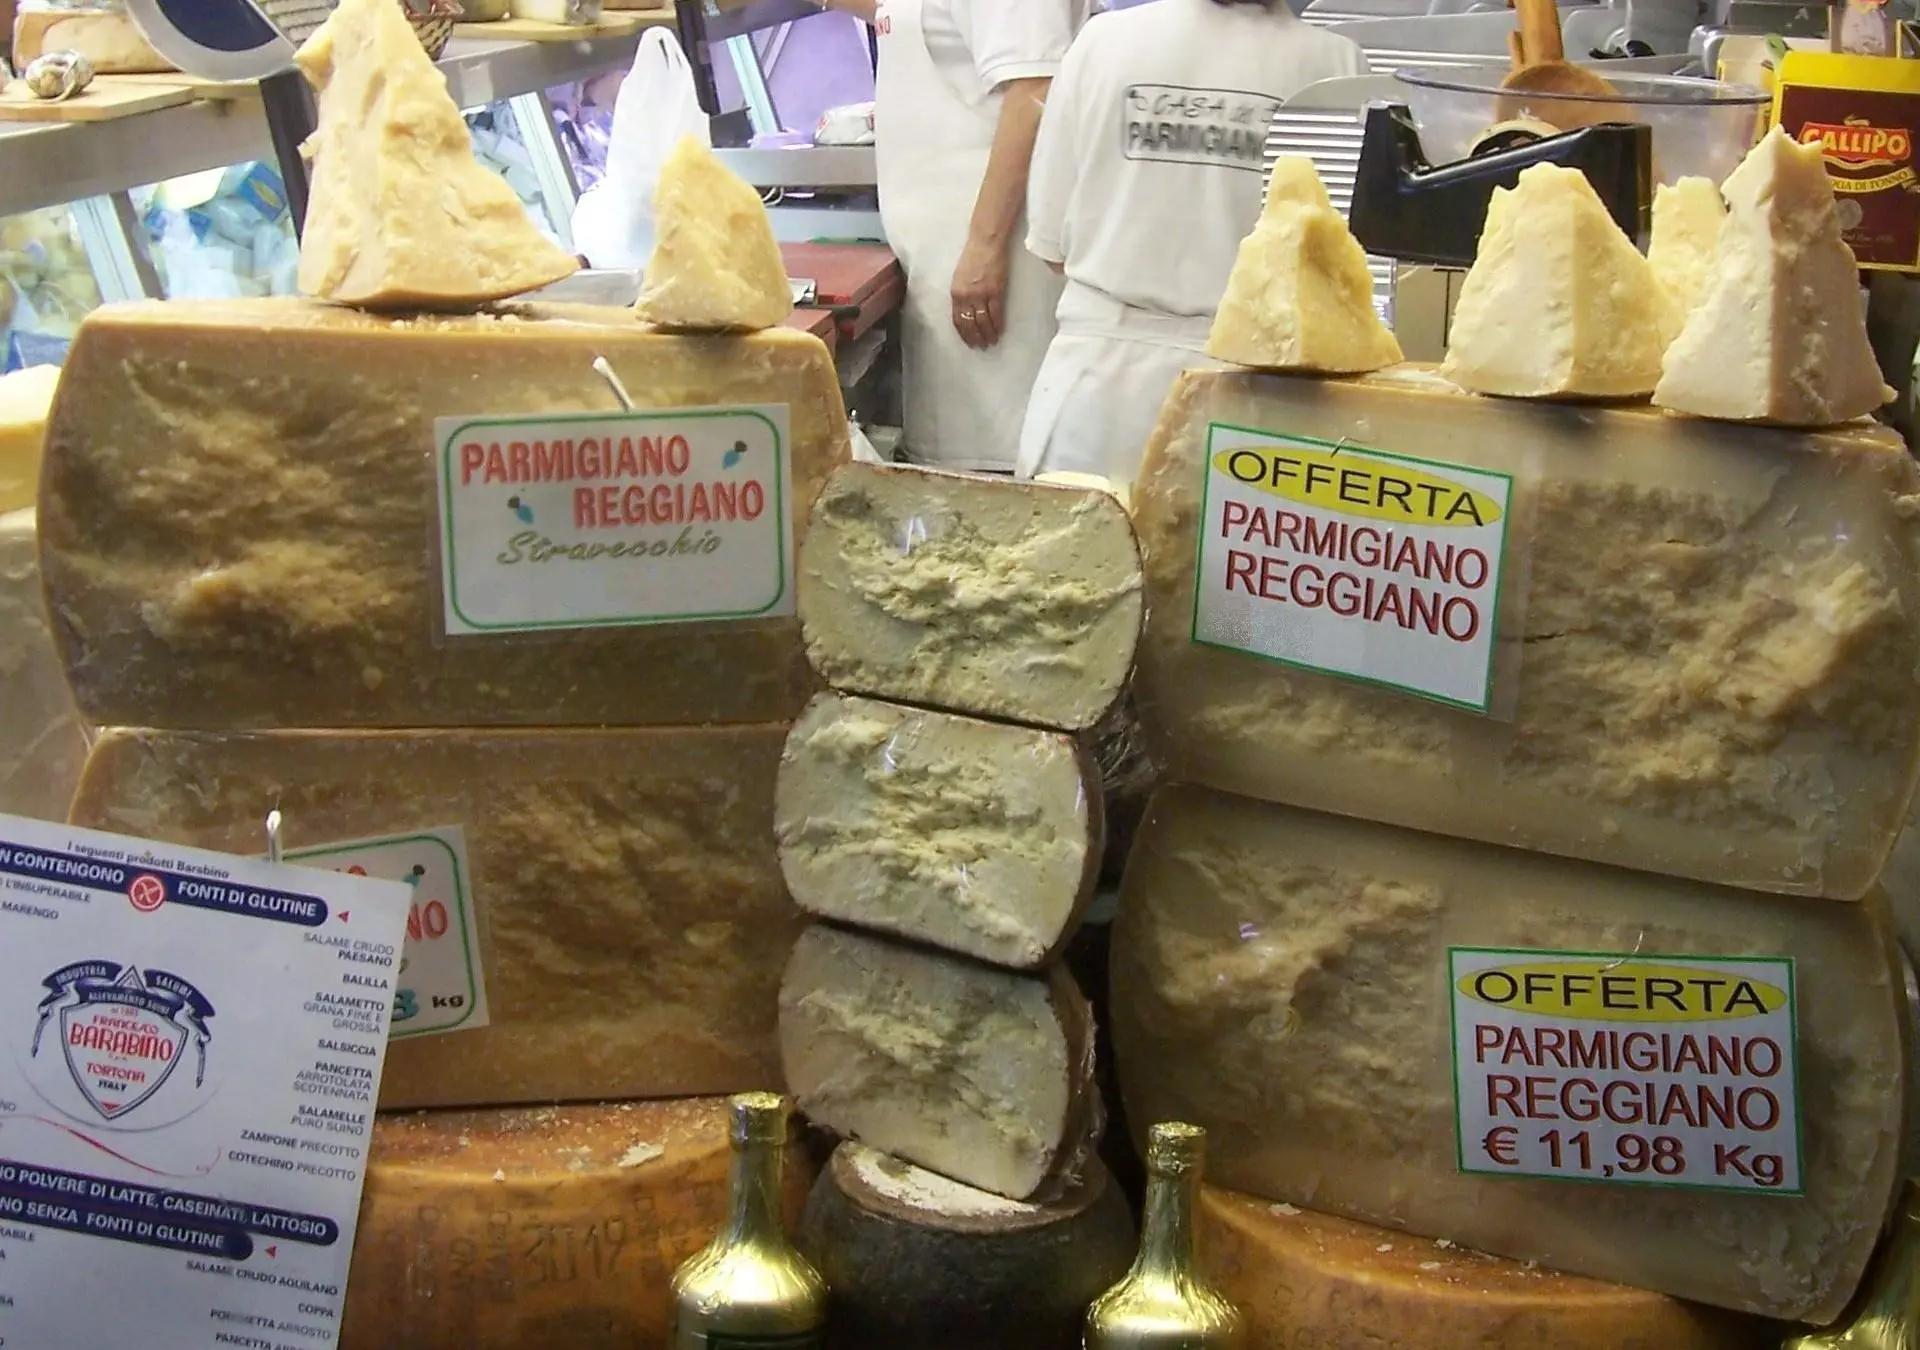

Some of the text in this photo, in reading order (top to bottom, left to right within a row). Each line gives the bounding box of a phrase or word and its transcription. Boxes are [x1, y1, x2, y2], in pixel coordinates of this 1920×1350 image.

[1128, 120, 1267, 162] PARMIGIAN
[1802, 128, 1907, 156] CALLIPO
[460, 433, 692, 487] PARMIGIANO
[1227, 450, 1485, 527] OFFERTA
[573, 479, 765, 529] REGGIANO
[1220, 499, 1490, 590] PARMIGIANO
[1224, 548, 1480, 643] REGGIANO
[74, 844, 125, 861] seguenti
[126, 853, 174, 869] prodotti
[176, 859, 230, 879] Barabino
[5, 878, 92, 904] L'INSUPERABILE
[14, 851, 125, 885] CONTENGONO
[177, 881, 225, 904] FONTI
[228, 888, 245, 905] DI
[248, 893, 318, 918] GLUTINE
[1, 901, 60, 921] MARENGO
[303, 931, 395, 956] SALAME CRUDO
[338, 949, 393, 968] PAESANO
[342, 973, 389, 990] BALILLA
[1474, 970, 1770, 1016] OFFERTA
[303, 1001, 346, 1018] GRANA
[347, 1007, 375, 1022] FINE
[314, 991, 386, 1013] SALAMETTO
[332, 1017, 381, 1035] GROSSA
[69, 1021, 174, 1063] BARABINO
[317, 1038, 378, 1057] SALSICCIA
[1475, 1024, 1783, 1079] PARMIGIANO
[296, 1070, 372, 1092] ARROTOLATA
[314, 1060, 374, 1080] PANCETTA
[293, 1079, 370, 1102] SCOTENNATA
[1486, 1073, 1781, 1132] REGGIANO
[290, 1114, 365, 1137] PURO SUINO
[298, 1104, 367, 1126] SALAMELLE
[240, 1128, 361, 1160] ZAMPONE PRECOTTO
[1481, 1126, 1785, 1187] € 11,98 Kg
[227, 1149, 357, 1182] COTECHINO PRECOTTO
[19, 1169, 87, 1195] POLVERE
[89, 1182, 107, 1199] DI
[251, 1211, 328, 1238] LATTOSIO
[26, 1201, 79, 1224] SENZA
[86, 1212, 134, 1234] FONTI
[136, 1222, 154, 1237] DI
[155, 1225, 226, 1250] GLUTINE
[235, 1267, 278, 1286] CRUDO
[278, 1276, 339, 1297] AQUILANO
[297, 1302, 335, 1320] COPPA
[214, 1331, 273, 1350] PANCETTA
